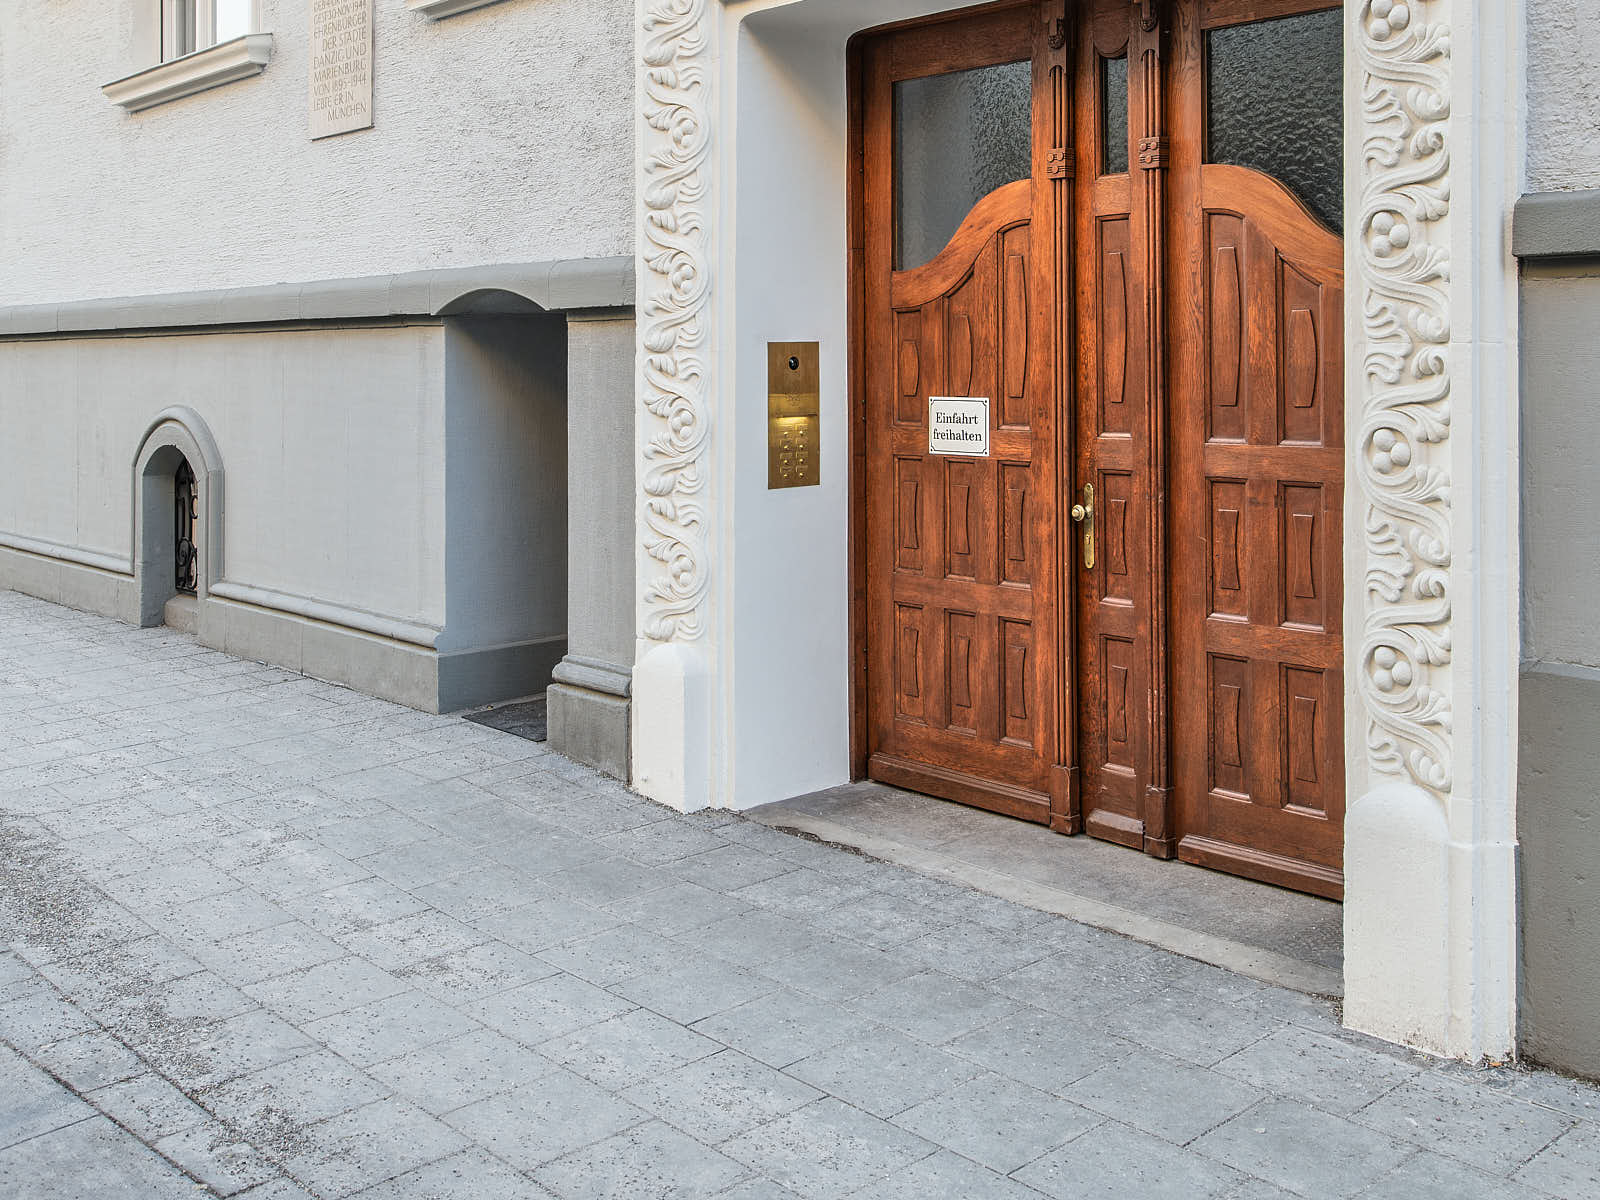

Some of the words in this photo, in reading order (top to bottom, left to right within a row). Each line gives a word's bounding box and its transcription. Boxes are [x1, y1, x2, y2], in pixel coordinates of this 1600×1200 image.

[322, 35, 337, 52] DER
[313, 48, 345, 70] DANZIG
[345, 42, 367, 60] UND
[313, 57, 367, 83] MARIENBURG
[334, 91, 344, 106] ER
[345, 89, 354, 104] IN
[936, 412, 979, 425] Einfahrt
[933, 428, 983, 441] freihalten
